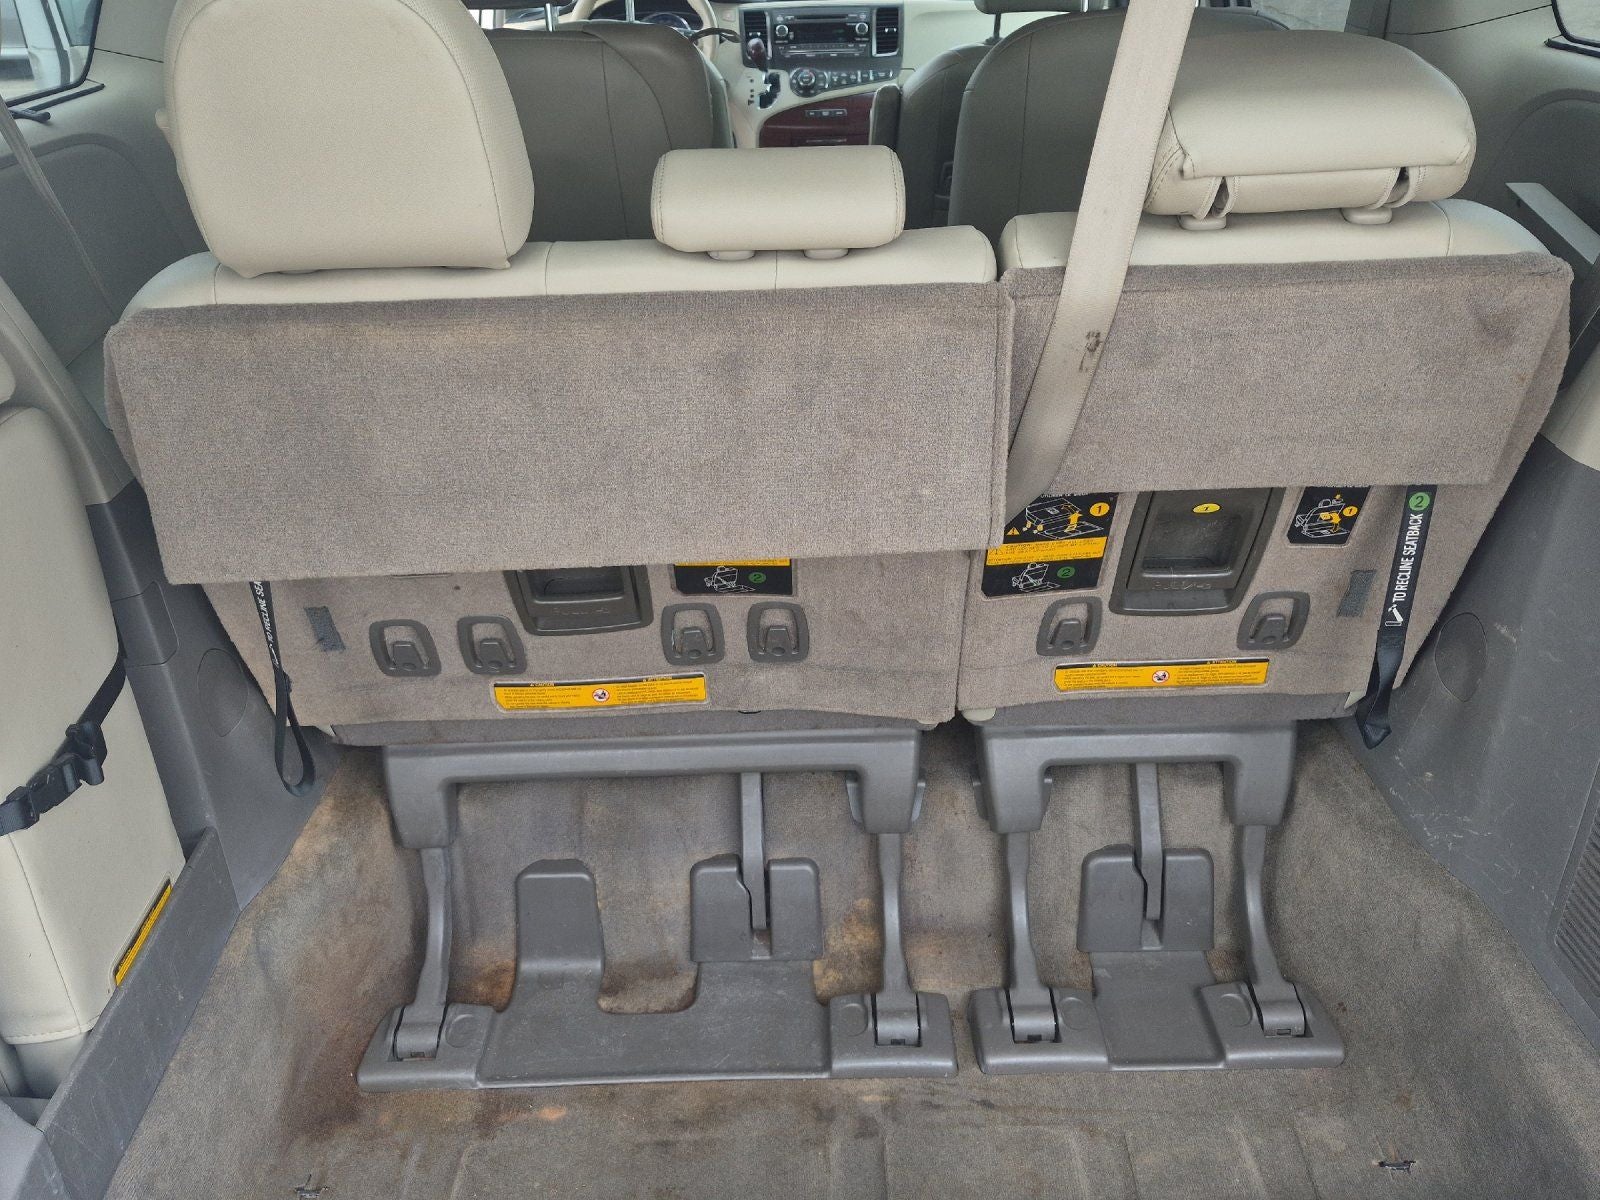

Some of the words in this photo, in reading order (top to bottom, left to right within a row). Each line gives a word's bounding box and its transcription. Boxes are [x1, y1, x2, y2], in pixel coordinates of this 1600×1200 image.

[1415, 495, 1424, 508] 2
[1096, 505, 1103, 514] 1
[1402, 513, 1424, 556] SEATBACK
[1061, 568, 1071, 577] 2
[1394, 557, 1415, 591] RECLINE
[1392, 590, 1407, 602] TO
[257, 597, 272, 632] RECLINE
